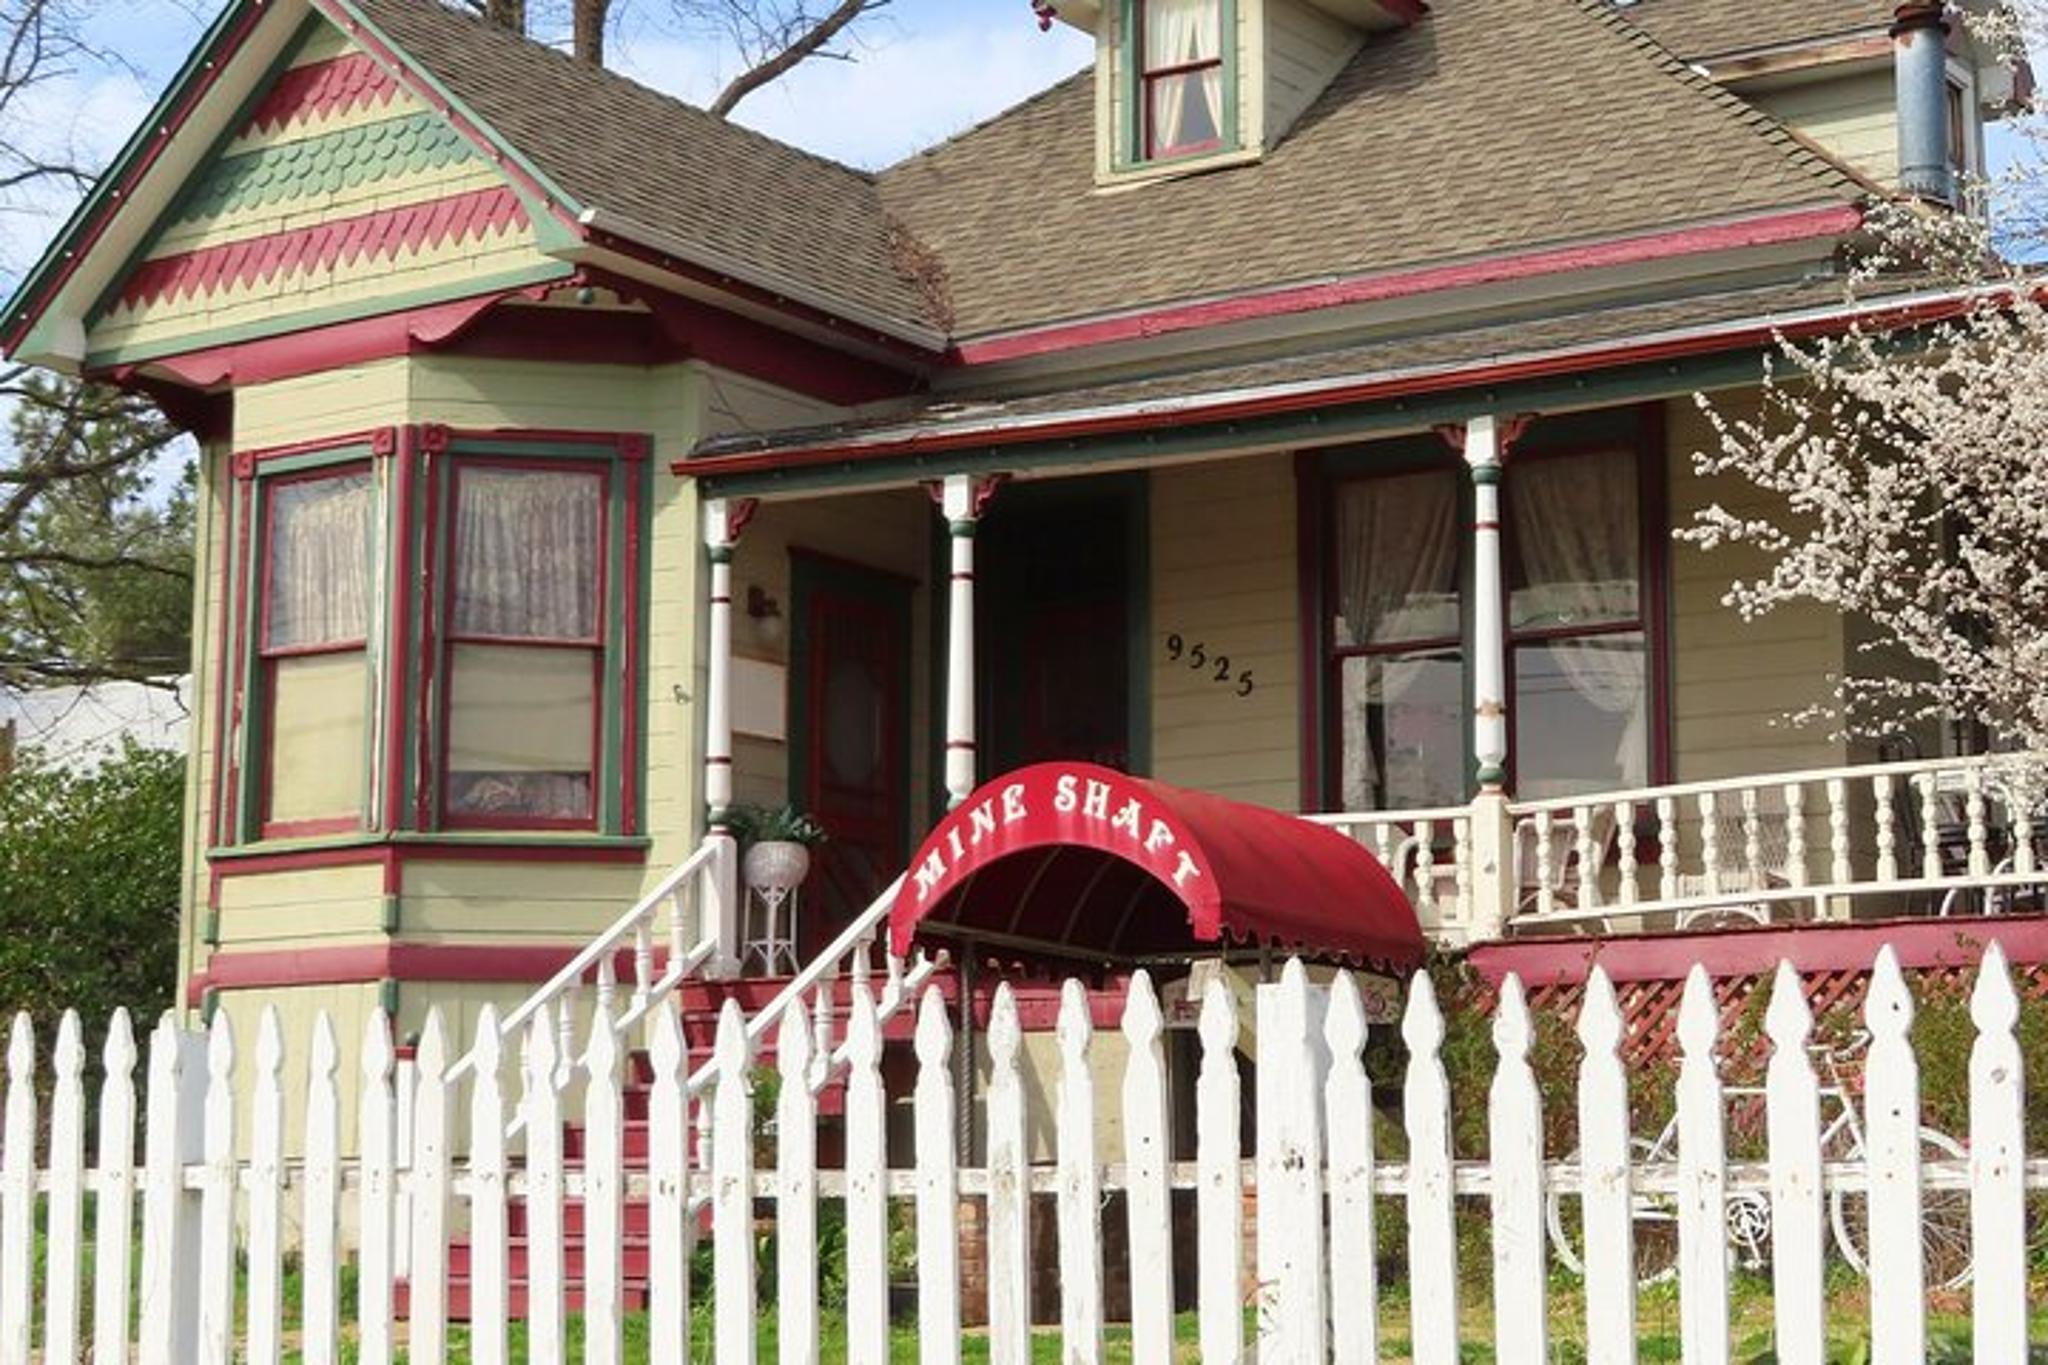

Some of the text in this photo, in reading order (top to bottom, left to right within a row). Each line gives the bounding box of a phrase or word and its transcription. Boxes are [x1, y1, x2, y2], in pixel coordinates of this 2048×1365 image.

[1167, 634, 1253, 697] 9525
[913, 774, 1200, 900] MINE SHAFT
